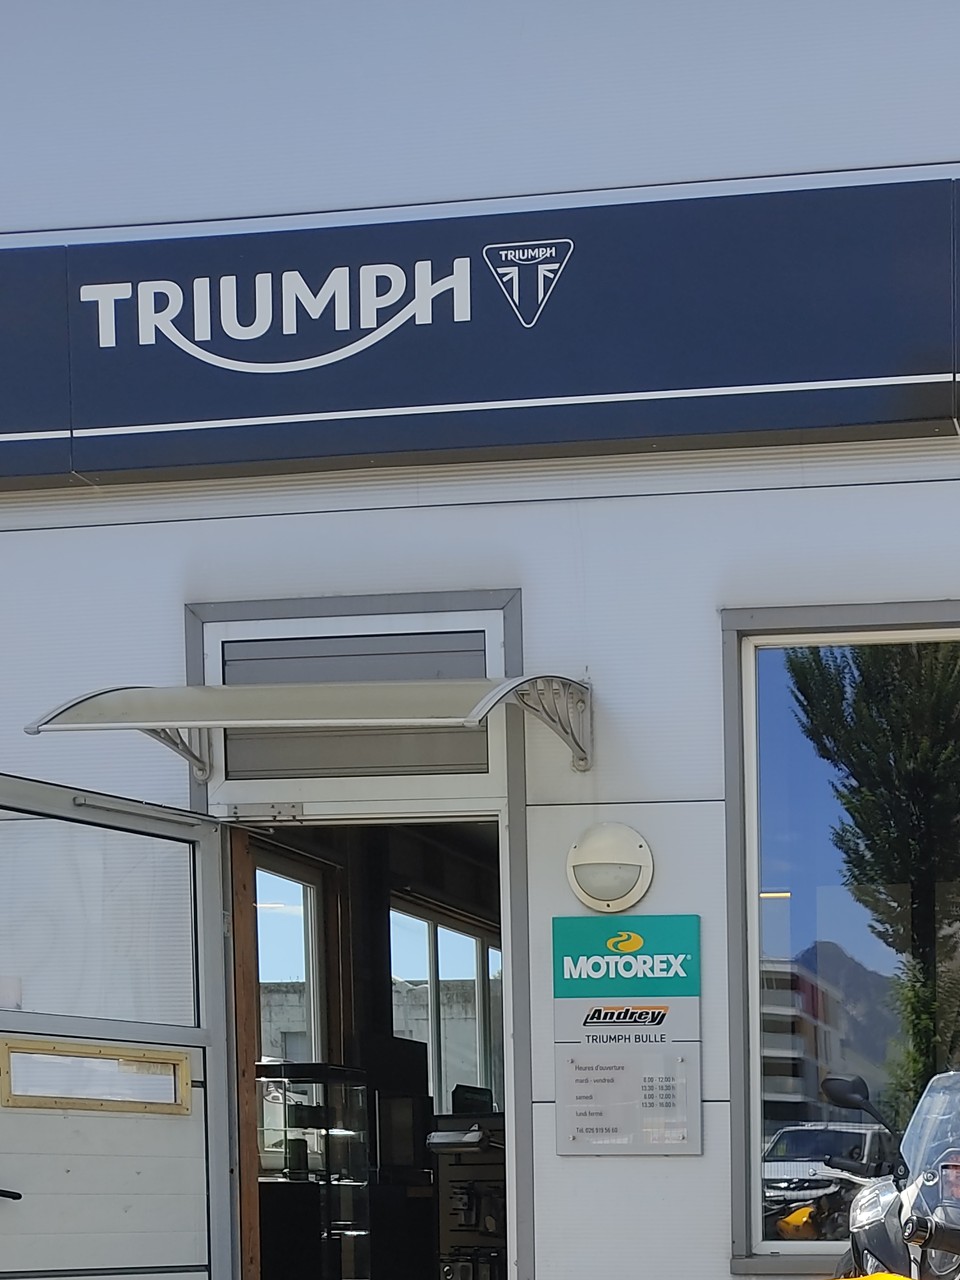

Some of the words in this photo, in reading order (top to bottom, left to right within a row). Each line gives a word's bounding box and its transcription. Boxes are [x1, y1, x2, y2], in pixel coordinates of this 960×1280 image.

[499, 246, 556, 265] TRIUMPH
[80, 257, 471, 374] TRIUMPH
[588, 1008, 662, 1025] Andrey
[585, 1034, 631, 1044] TRIUMPH
[634, 1034, 666, 1043] BULLE
